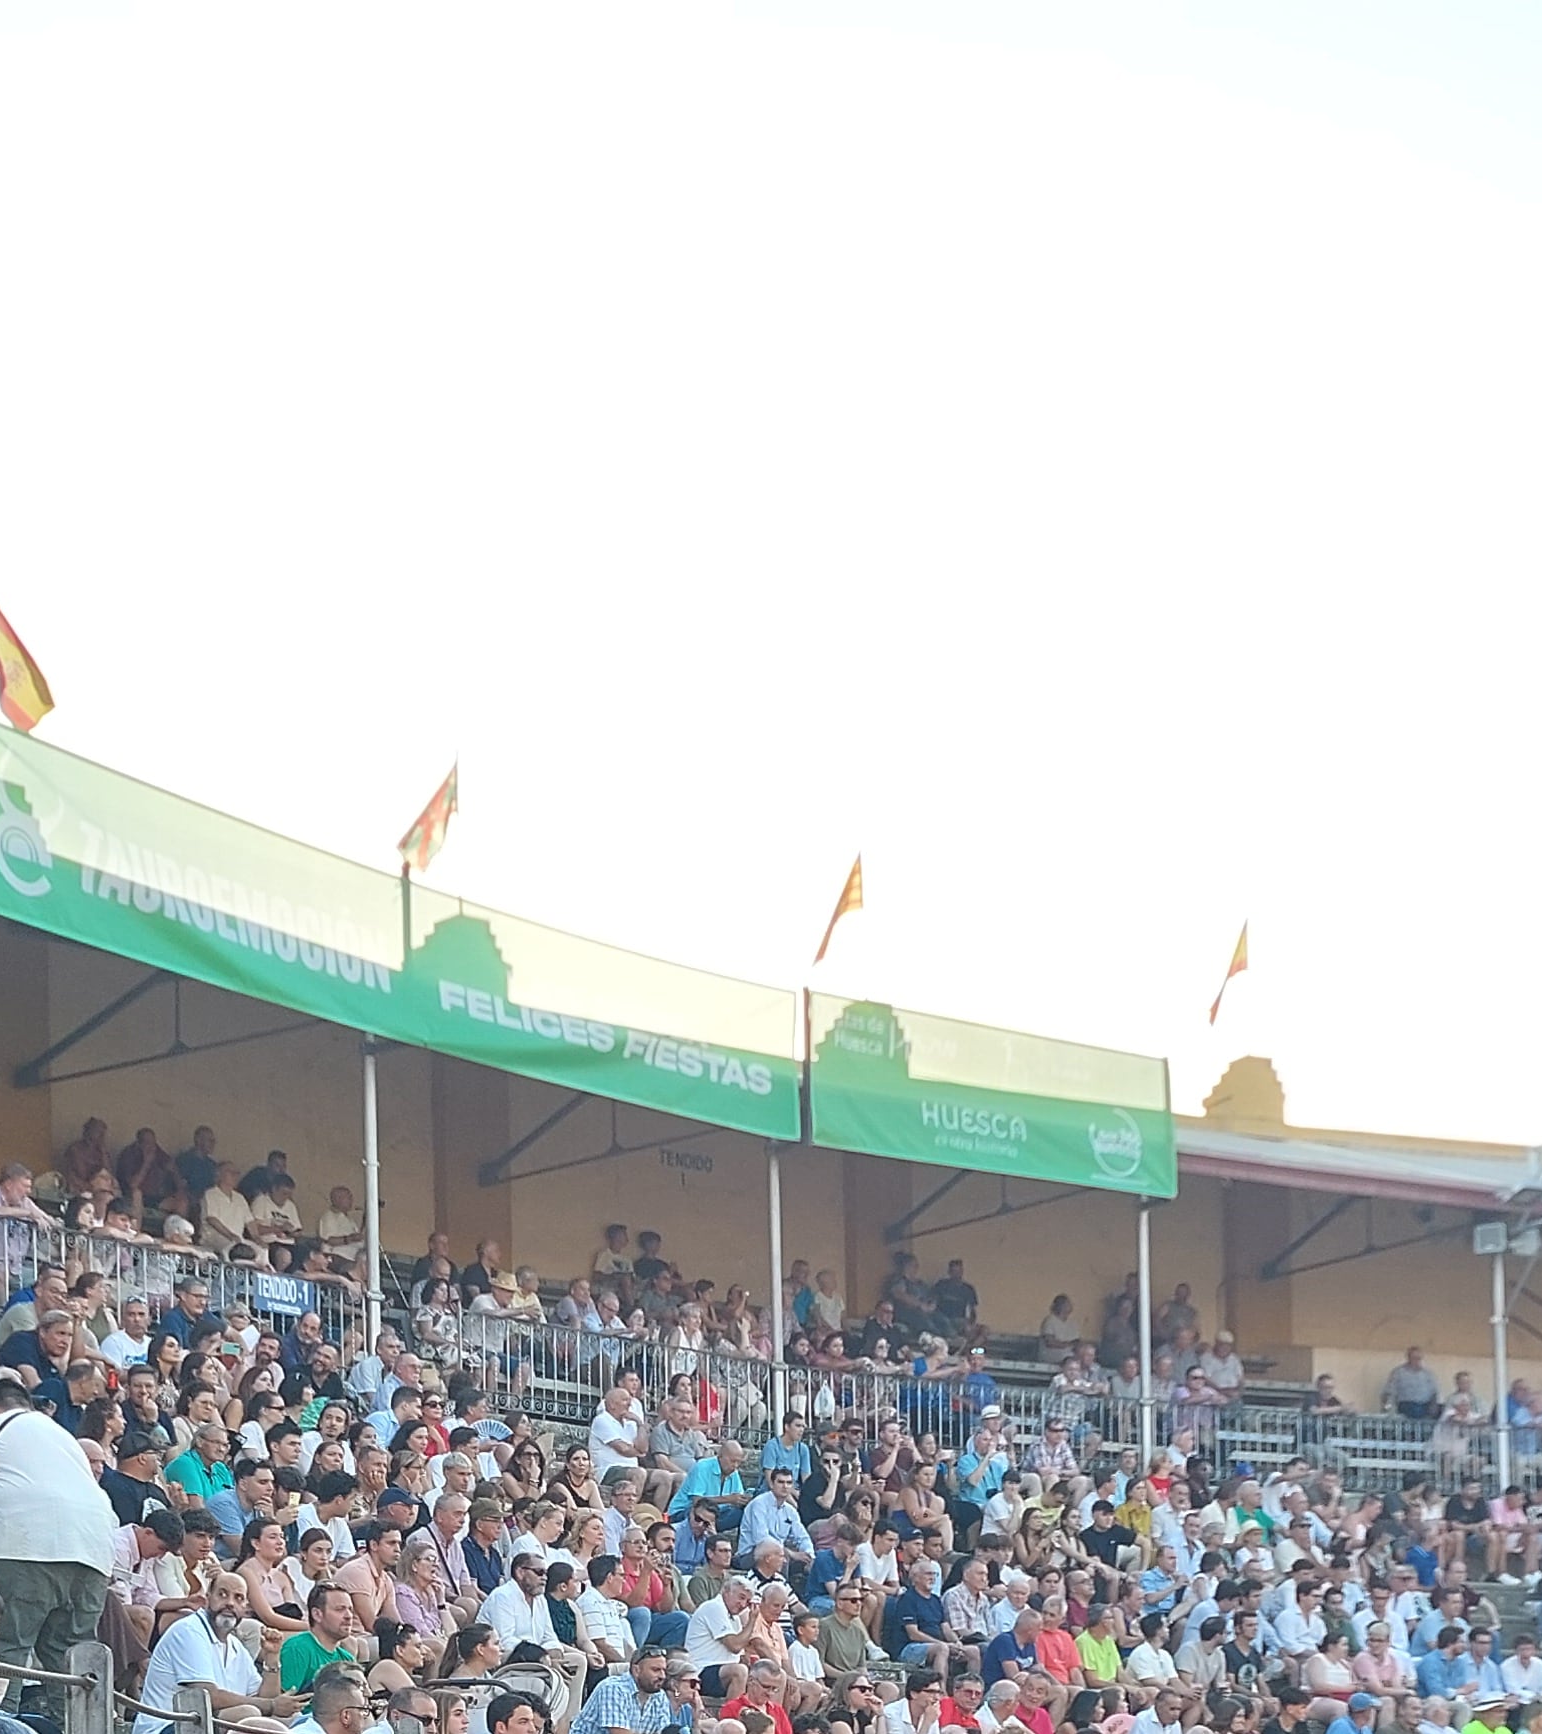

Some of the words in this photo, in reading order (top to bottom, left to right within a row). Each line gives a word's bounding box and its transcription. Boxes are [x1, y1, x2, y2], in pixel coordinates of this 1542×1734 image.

[77, 823, 392, 994] TAUROEMOCIÓN
[438, 979, 616, 1053] FELICES
[622, 1030, 773, 1096] FIESTAS
[921, 1100, 1028, 1142] HUESCA
[660, 1149, 713, 1174] TENDIDO
